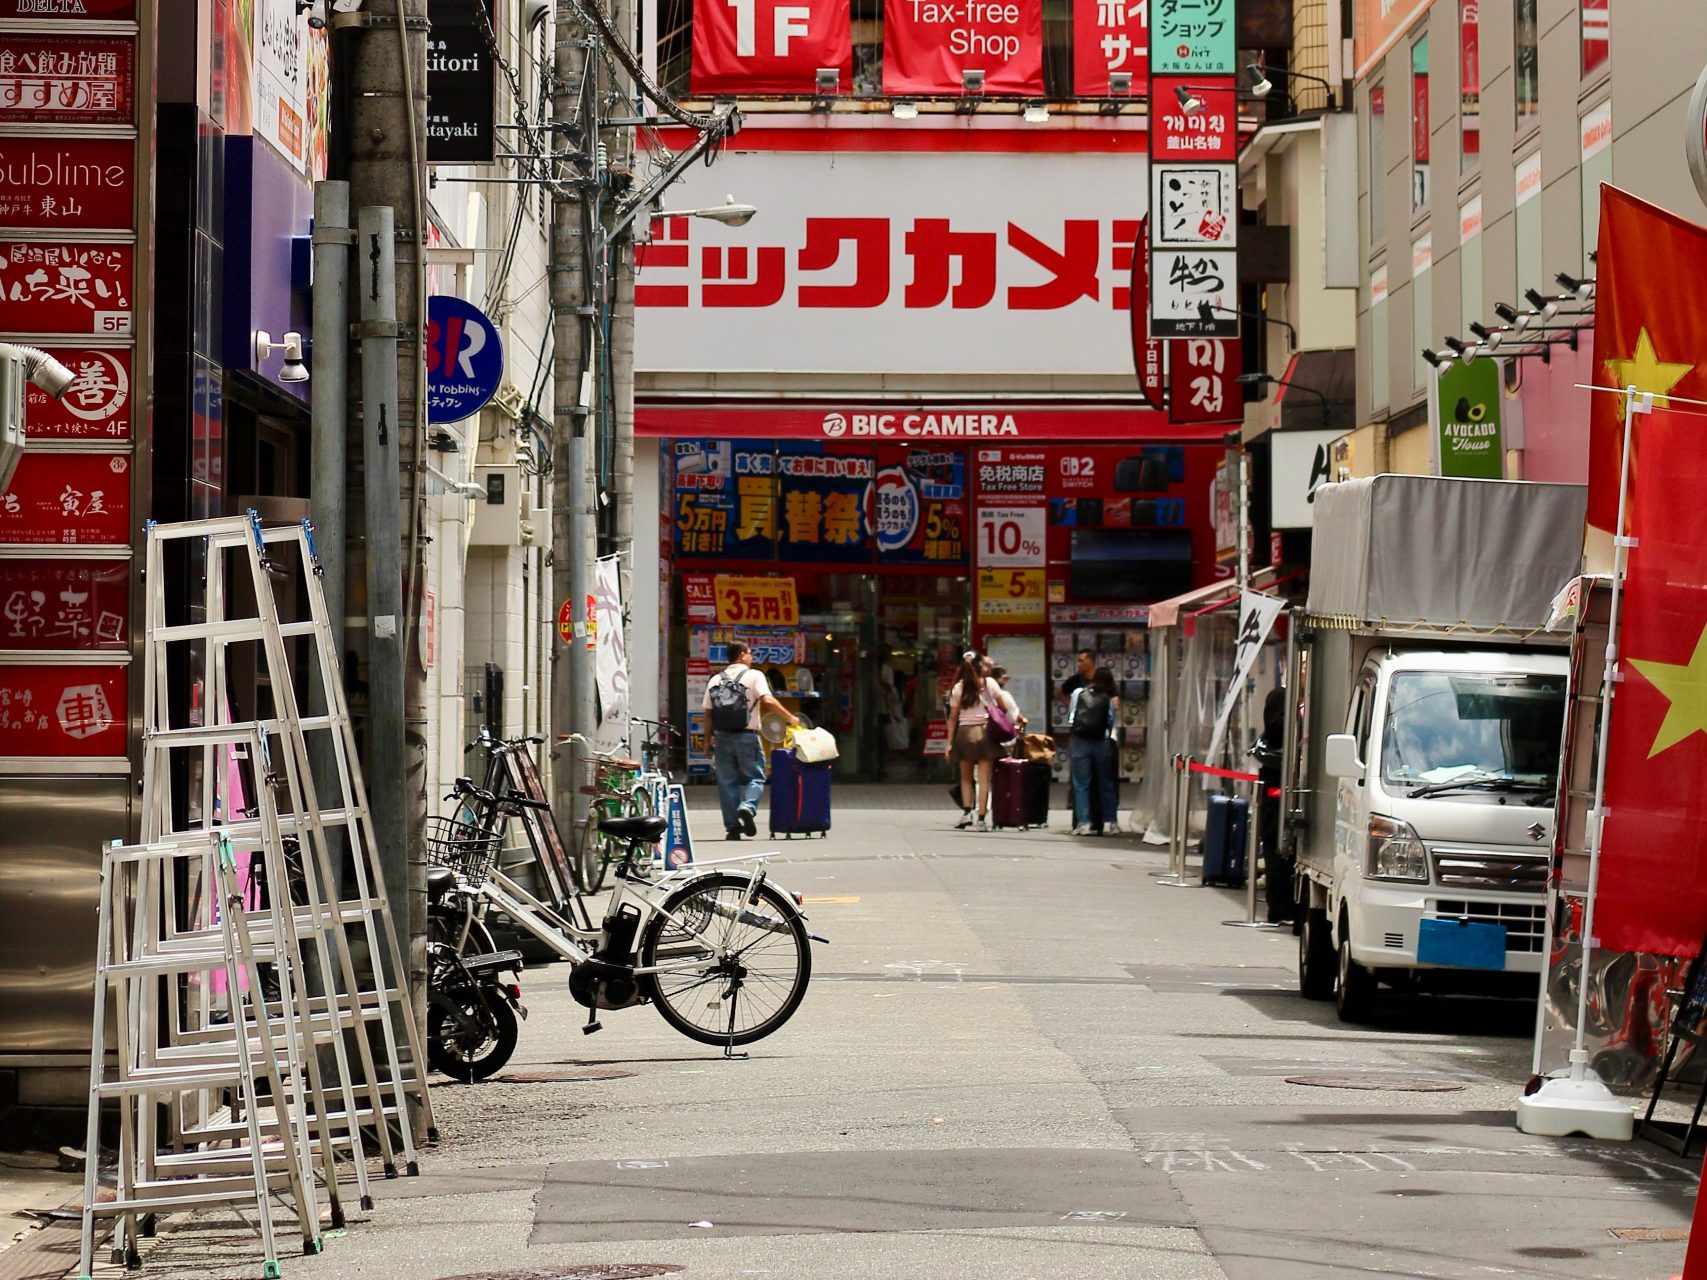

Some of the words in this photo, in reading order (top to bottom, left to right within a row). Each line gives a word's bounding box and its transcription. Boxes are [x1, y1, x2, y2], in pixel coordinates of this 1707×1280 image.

[1160, 19, 1227, 38] ショップ
[948, 27, 1021, 61] Shop
[0, 49, 118, 77] 食べ飲み放題
[1166, 134, 1222, 151] 釜山名物
[39, 194, 82, 219] 東山
[103, 316, 129, 331] 5F
[66, 359, 119, 406] 善
[27, 392, 48, 404] 前店
[106, 420, 128, 436] 4F
[851, 414, 896, 437] BIC
[902, 413, 1019, 437] CAMERA
[1444, 421, 1497, 437] AVOCADO
[1451, 437, 1491, 451] House
[978, 465, 1045, 483] 免税商店
[980, 482, 998, 492] Tax
[998, 482, 1018, 492] Free
[1019, 482, 1044, 492] Store
[59, 483, 109, 518] 寅屋
[677, 493, 727, 532] 5万円
[735, 475, 862, 545] 買替祭
[925, 502, 961, 539] 5%
[982, 521, 1041, 556] 10%
[686, 585, 713, 599] SALE
[725, 588, 781, 621] 3万円
[63, 692, 97, 734] 車
